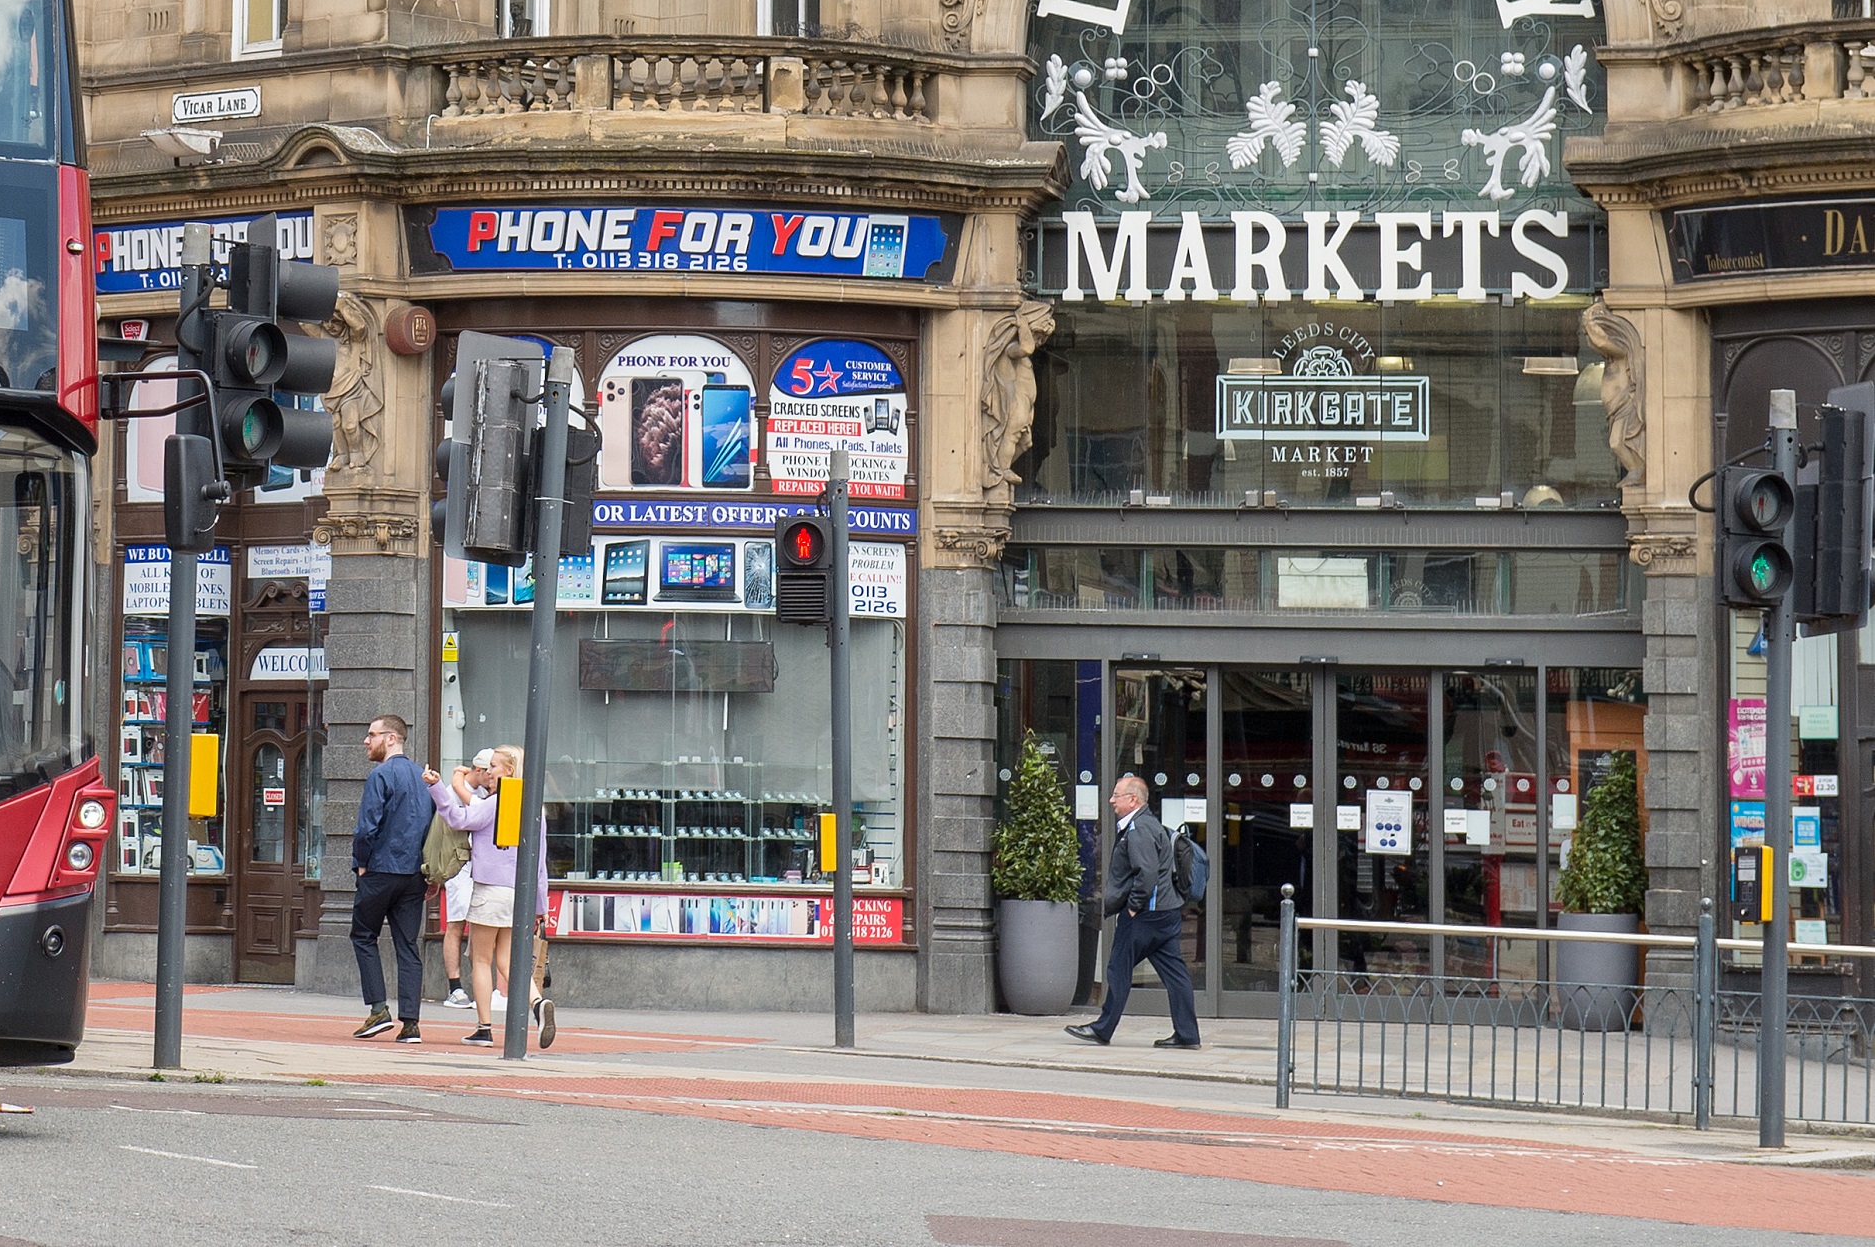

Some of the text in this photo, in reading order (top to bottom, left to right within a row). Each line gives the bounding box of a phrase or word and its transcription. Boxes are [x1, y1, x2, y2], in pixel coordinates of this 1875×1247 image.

[183, 96, 247, 116] VICAR LANE
[467, 209, 870, 259] PHONE FOR YOU
[1705, 209, 1875, 272] Tobacconist DA
[95, 216, 314, 274] PHONE OU
[553, 252, 748, 272] T: 0113 318 2126
[1061, 210, 1571, 303] MARKETS
[1272, 322, 1375, 360] LEEDS CITY
[617, 354, 731, 368] PHONE FOR YOU
[791, 358, 892, 395] 5 CUSTOMER
[852, 370, 888, 382] SERVICE
[774, 402, 860, 419] CRACKED SCREENS
[1232, 390, 1413, 426] KIRKGATE
[775, 421, 858, 435] REPLACED HERE!!
[775, 436, 902, 454] All Phones, Tablets
[1271, 446, 1374, 463] MARKET
[782, 455, 897, 470] PHONE UOCKING &
[786, 467, 831, 479] WINDO
[1301, 467, 1349, 477] est. 1857
[778, 480, 820, 493] REPAIRS
[854, 484, 874, 496] YOU
[874, 485, 901, 497] WAIT!!
[628, 505, 708, 524] LATEST
[128, 548, 230, 562] WE BUY SELL
[254, 546, 300, 556] Memory Cards
[861, 546, 900, 557] SCREEN?
[253, 557, 299, 566] Screen Repairs
[851, 559, 895, 570] PROBLEM
[140, 567, 161, 578] ALL
[200, 567, 216, 578] OF
[261, 567, 291, 576] Bluetooth
[858, 573, 885, 583] CALL
[129, 582, 170, 593] MOBILE
[851, 584, 888, 599] 0113
[1390, 578, 1413, 597] EEDS
[126, 598, 170, 608] LAPTOPS
[854, 599, 897, 614] 2126
[1512, 819, 1525, 828] Eat
[825, 898, 892, 912] UOCKING
[869, 926, 893, 938] 2126
